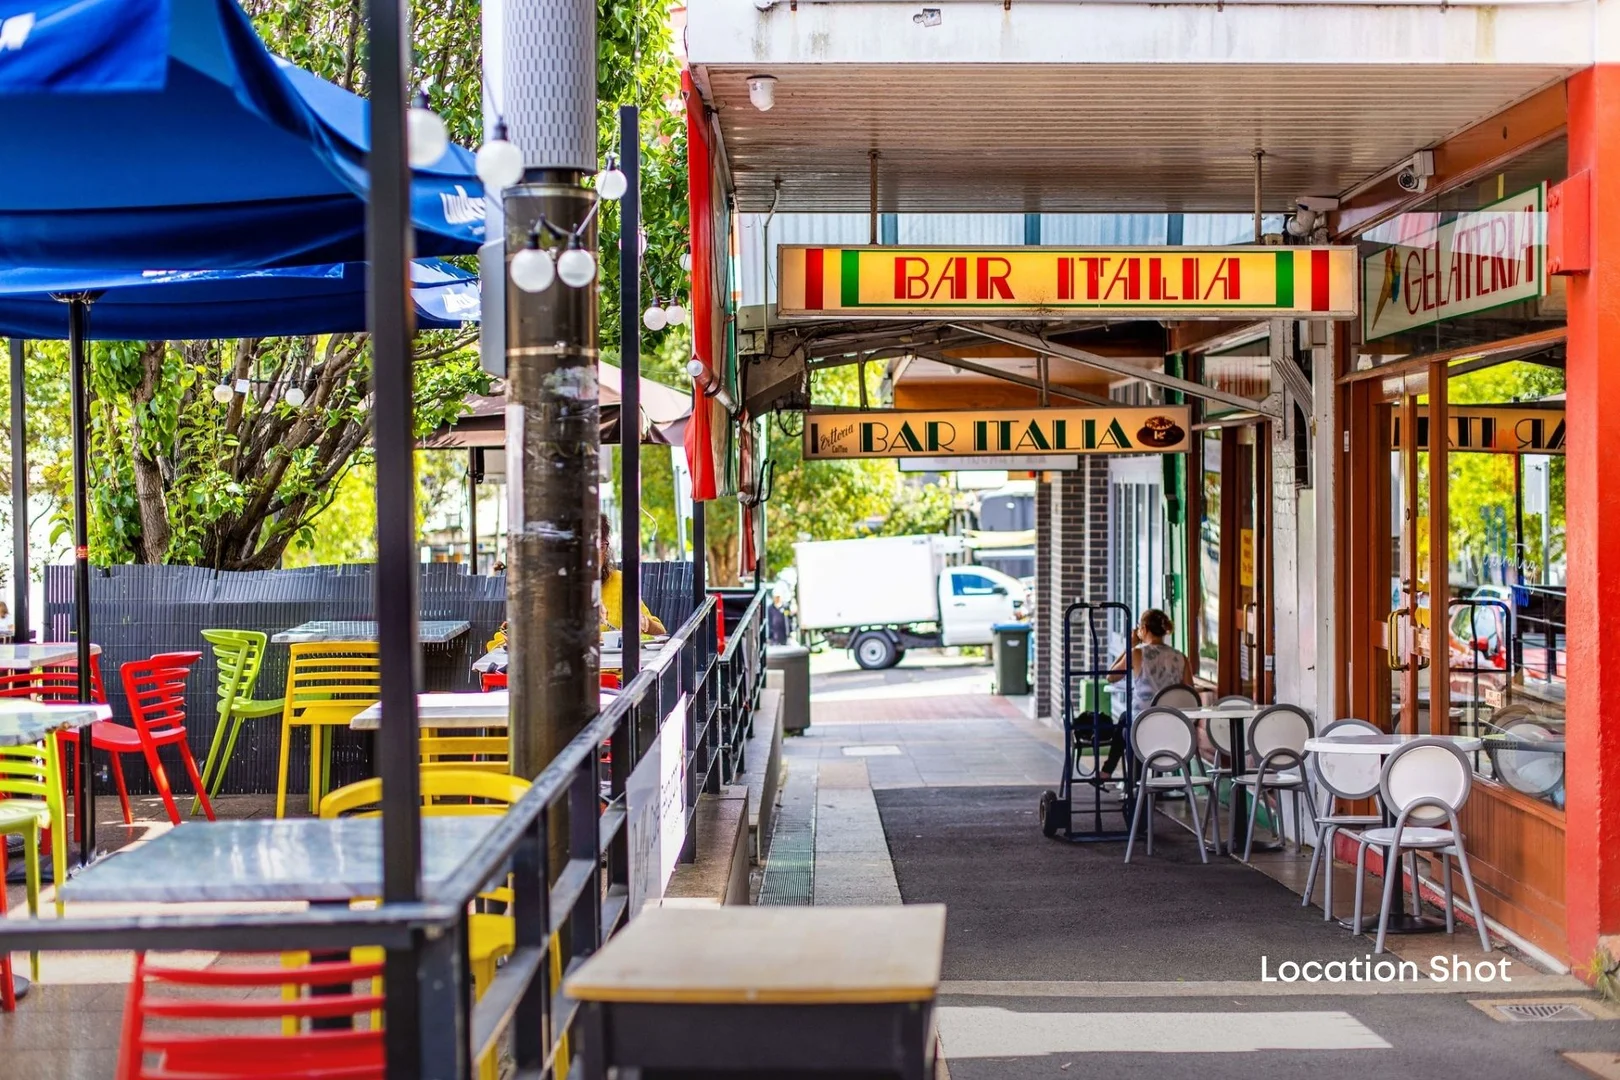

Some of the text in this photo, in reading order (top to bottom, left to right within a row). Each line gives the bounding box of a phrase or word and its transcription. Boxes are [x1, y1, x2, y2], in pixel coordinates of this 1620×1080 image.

[894, 257, 1241, 300] BAR ITALIA
[1404, 204, 1534, 315] GELATERIA
[859, 416, 1134, 453] BAR ITALIA
